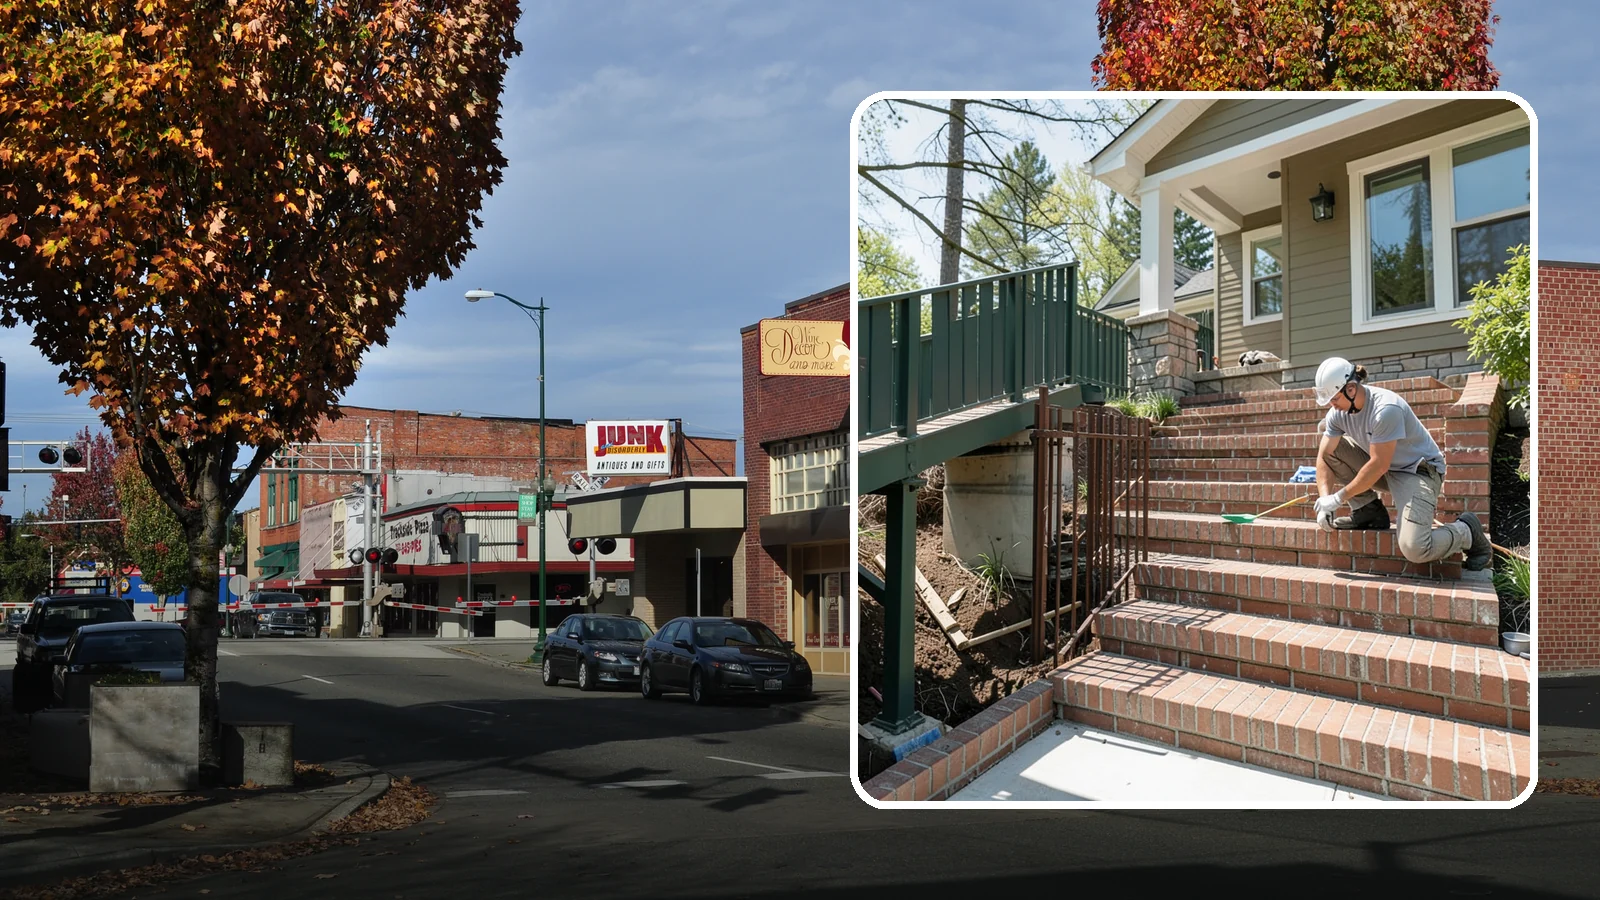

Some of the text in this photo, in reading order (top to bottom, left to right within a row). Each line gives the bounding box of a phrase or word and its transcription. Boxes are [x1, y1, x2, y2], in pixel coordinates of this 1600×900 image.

[595, 425, 664, 457] JUNK
[607, 446, 646, 454] DISORDERLY
[596, 460, 665, 470] ANTIQUES AND GIFTS
[590, 475, 609, 491] SING
[390, 519, 429, 539] Trackside Pizza
